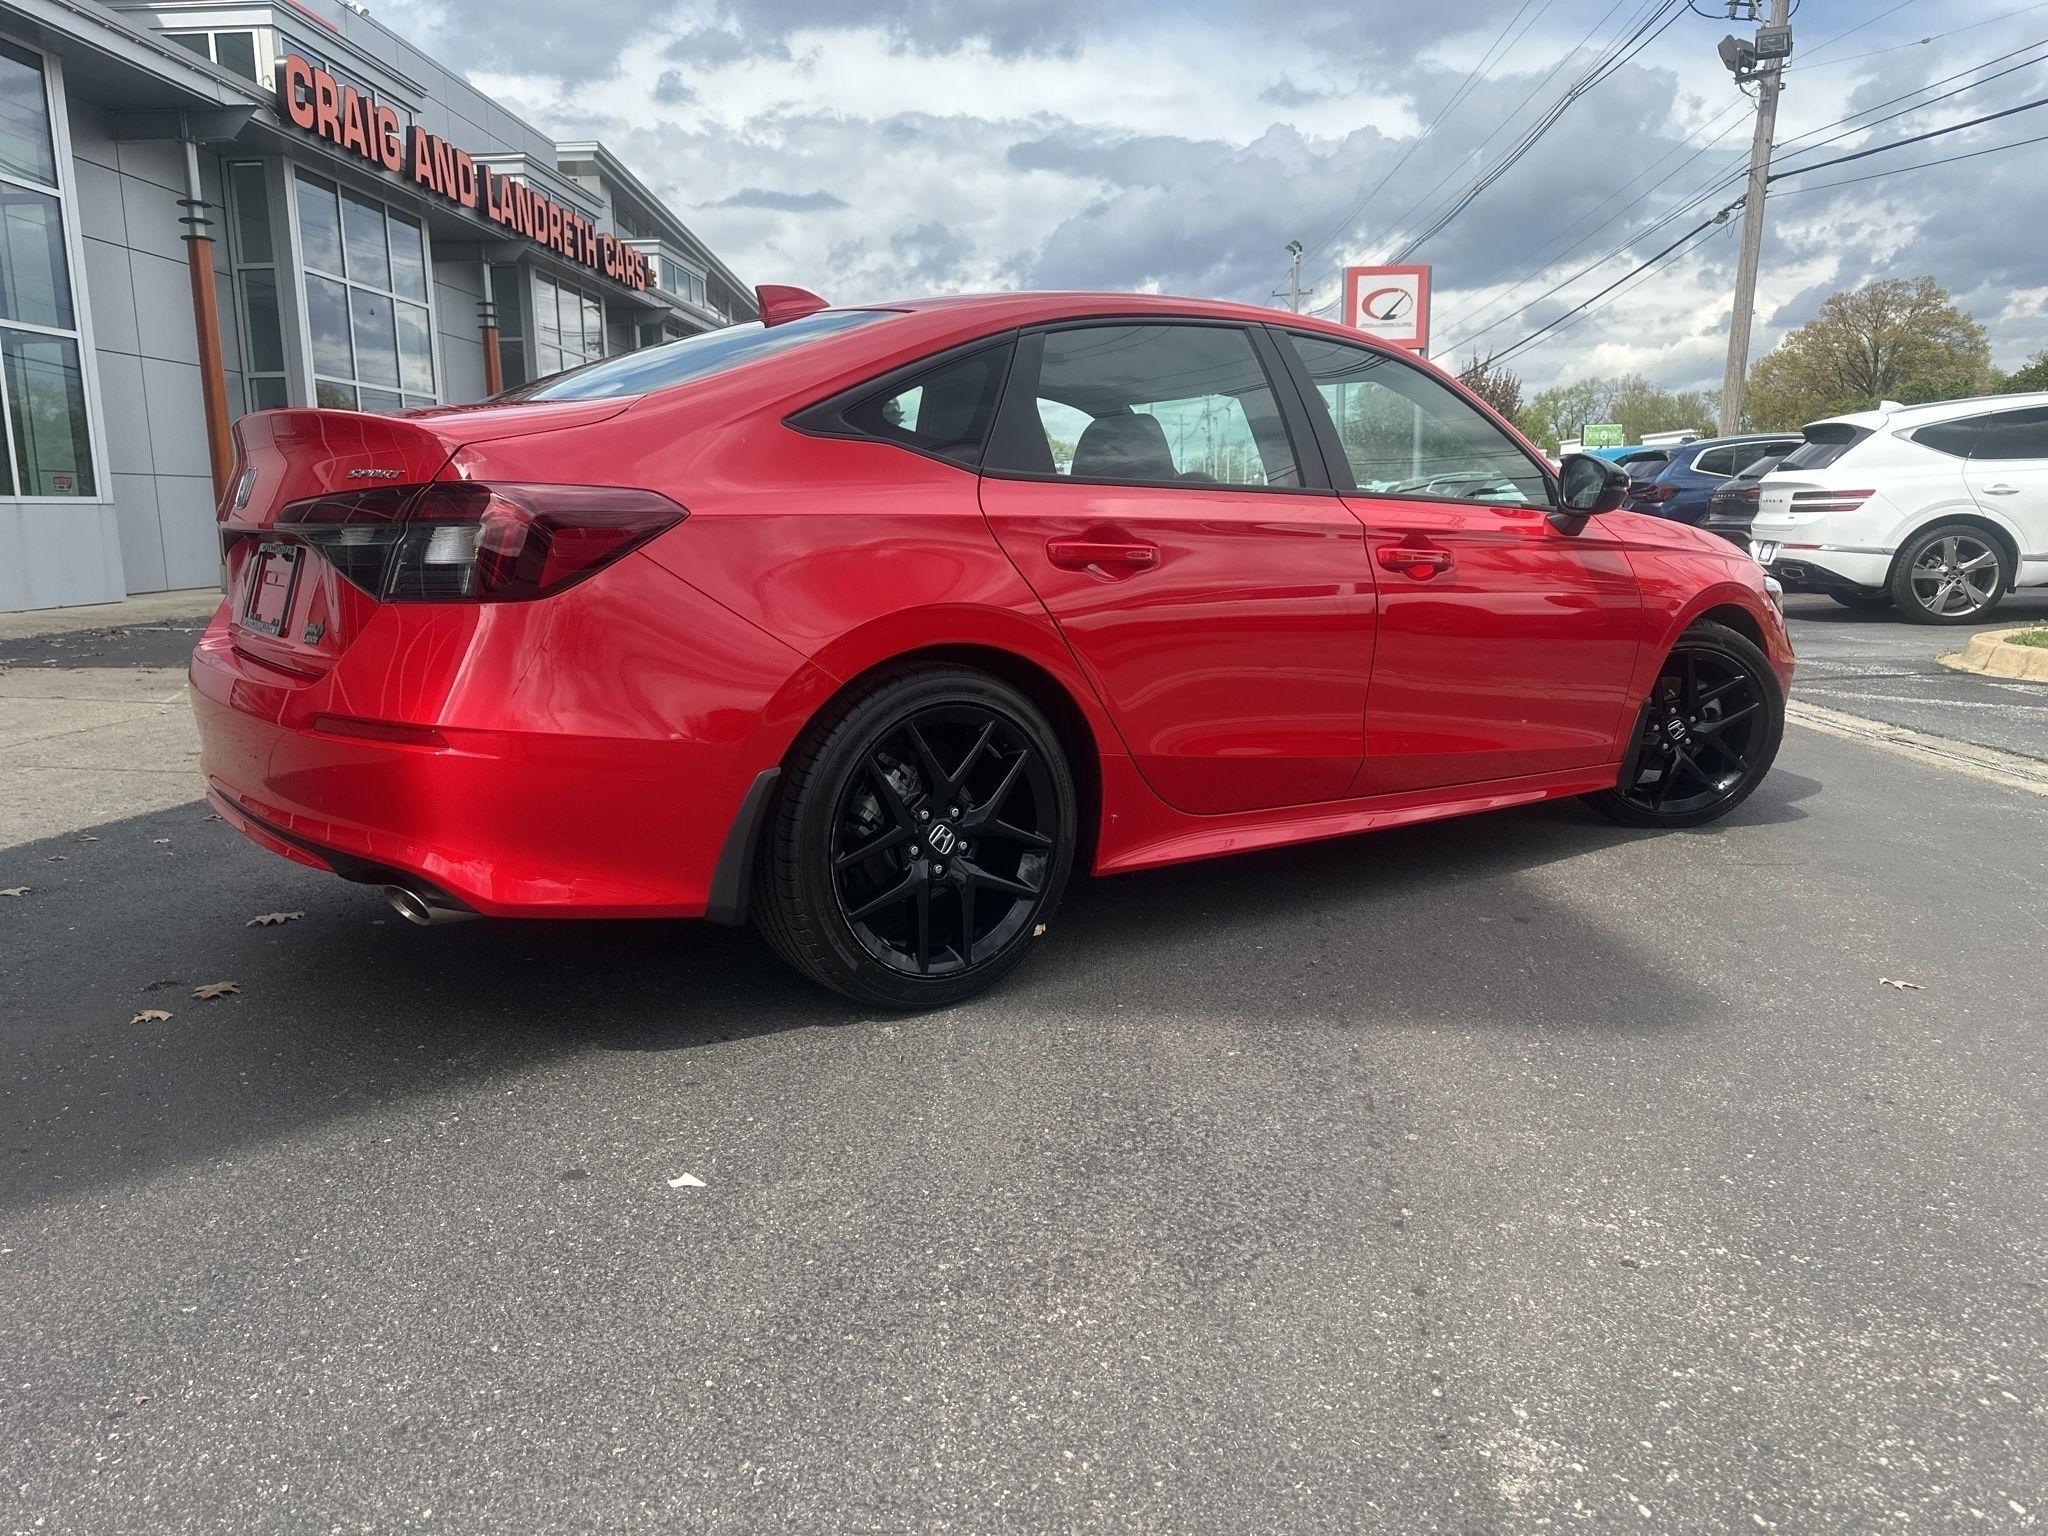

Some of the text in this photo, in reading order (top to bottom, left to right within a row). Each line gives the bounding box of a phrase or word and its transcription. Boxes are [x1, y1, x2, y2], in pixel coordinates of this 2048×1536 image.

[283, 53, 401, 172] CRAIG
[414, 125, 476, 209] AND
[485, 164, 599, 269] LANDRETH
[602, 232, 645, 292] CARS
